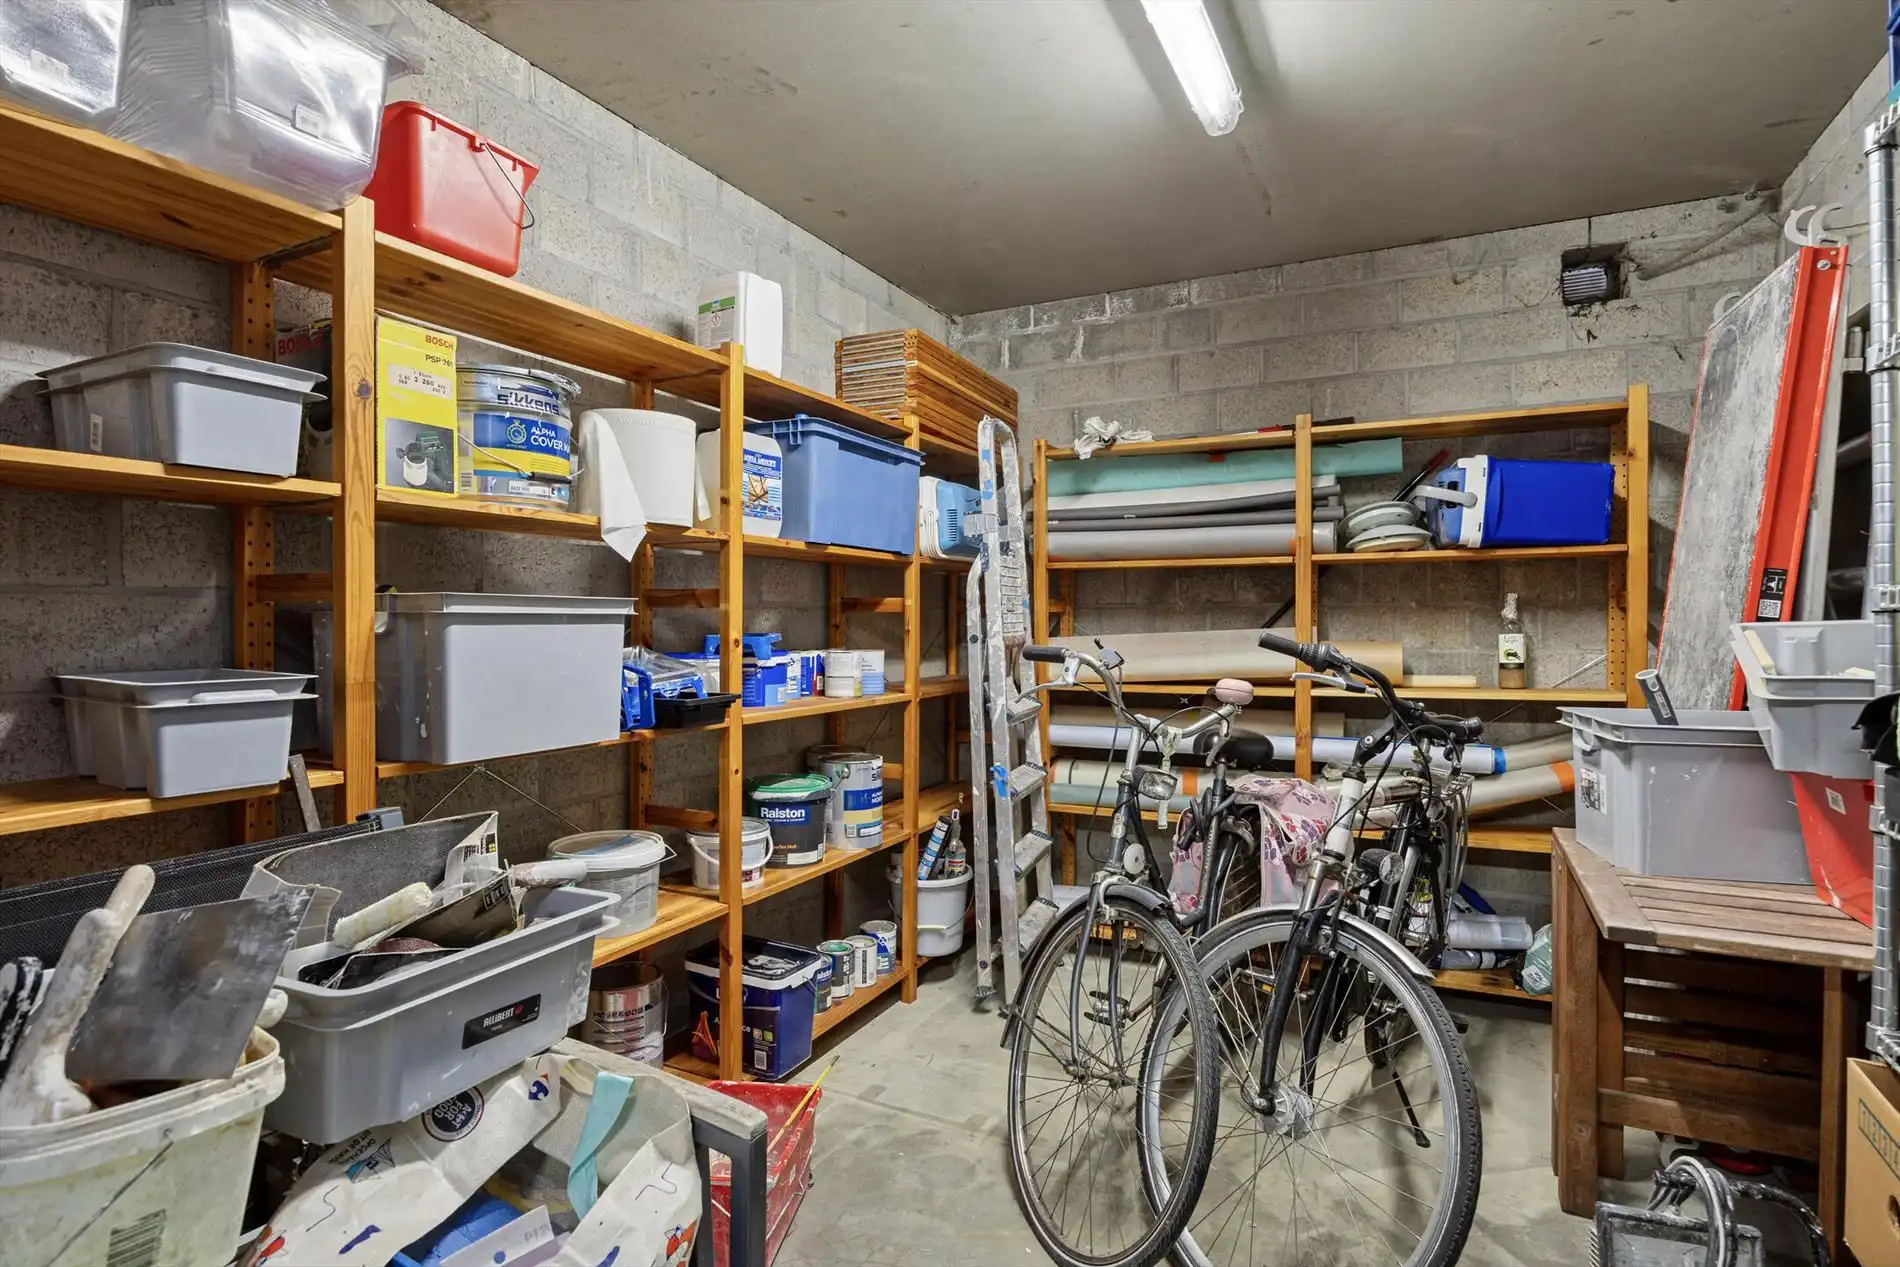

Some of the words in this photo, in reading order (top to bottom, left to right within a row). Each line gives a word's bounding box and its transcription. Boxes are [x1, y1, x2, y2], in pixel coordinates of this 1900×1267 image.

[425, 335, 454, 350] BOSCH
[425, 353, 441, 364] PSP
[531, 426, 556, 438] ALPHA
[530, 435, 563, 450] COVER
[760, 807, 805, 819] Ralston
[444, 1100, 463, 1121] FOR
